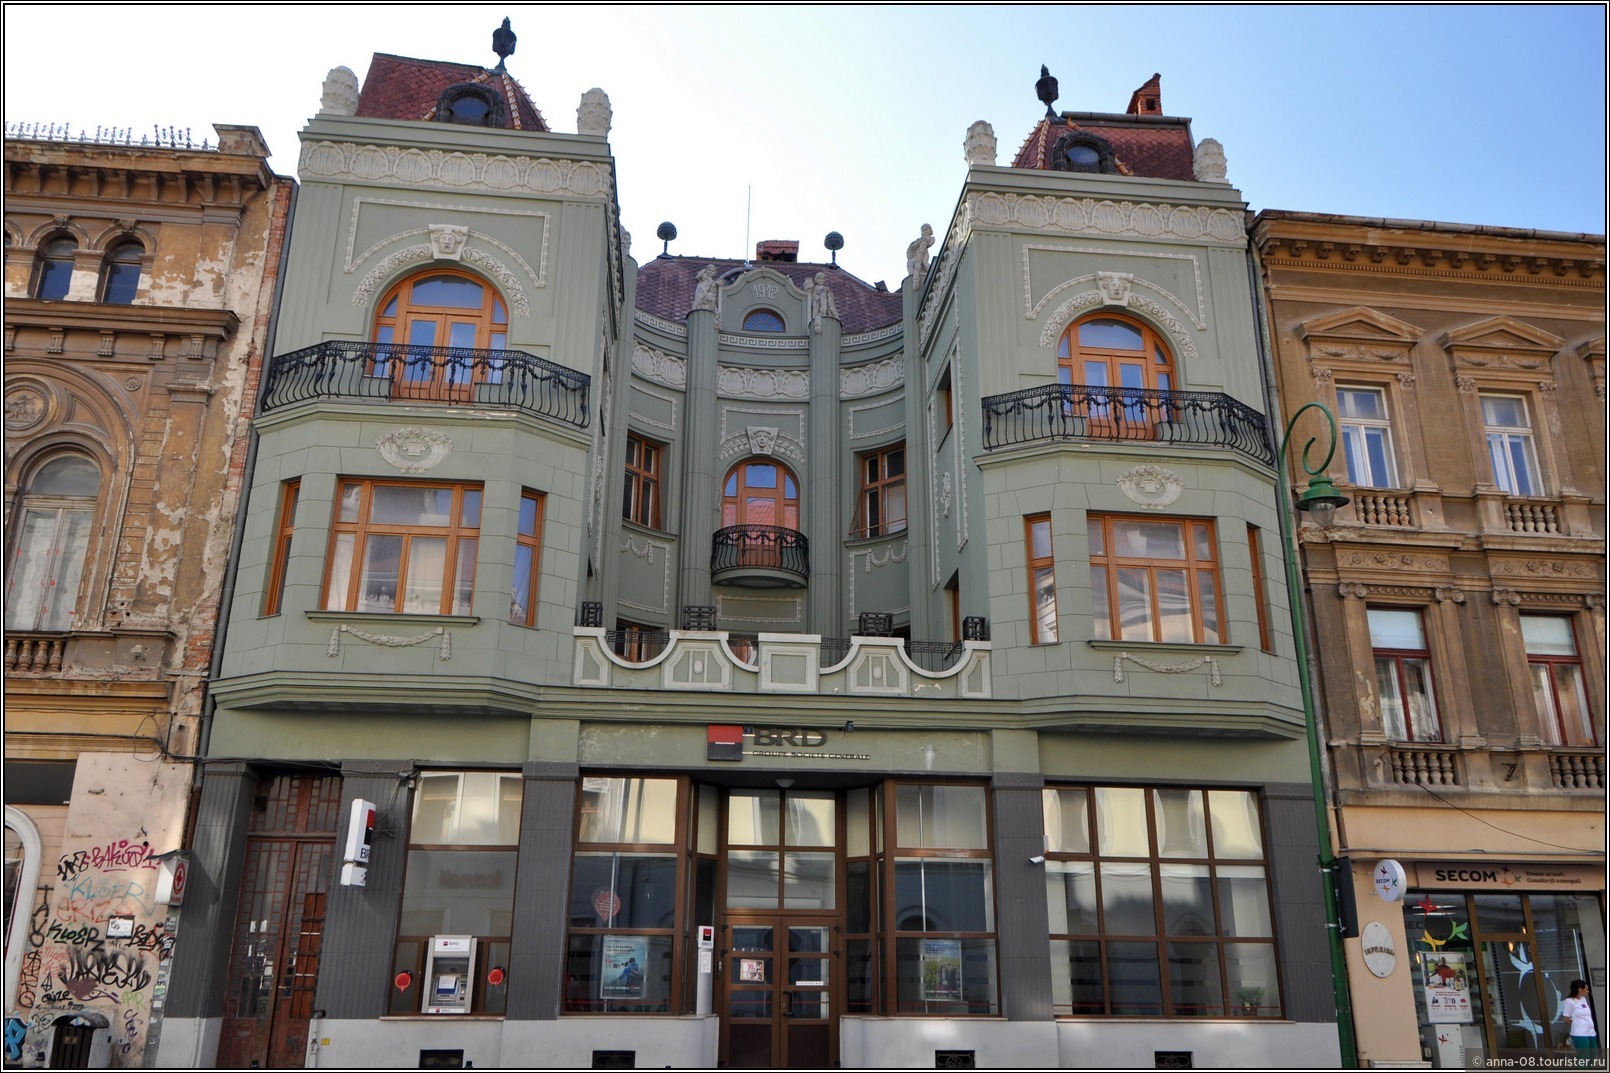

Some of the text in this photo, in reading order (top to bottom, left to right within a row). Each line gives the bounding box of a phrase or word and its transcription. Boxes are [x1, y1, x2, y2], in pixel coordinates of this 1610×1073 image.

[753, 283, 779, 299] 1912
[753, 728, 828, 747] BRD
[1435, 869, 1498, 882] SECOM
